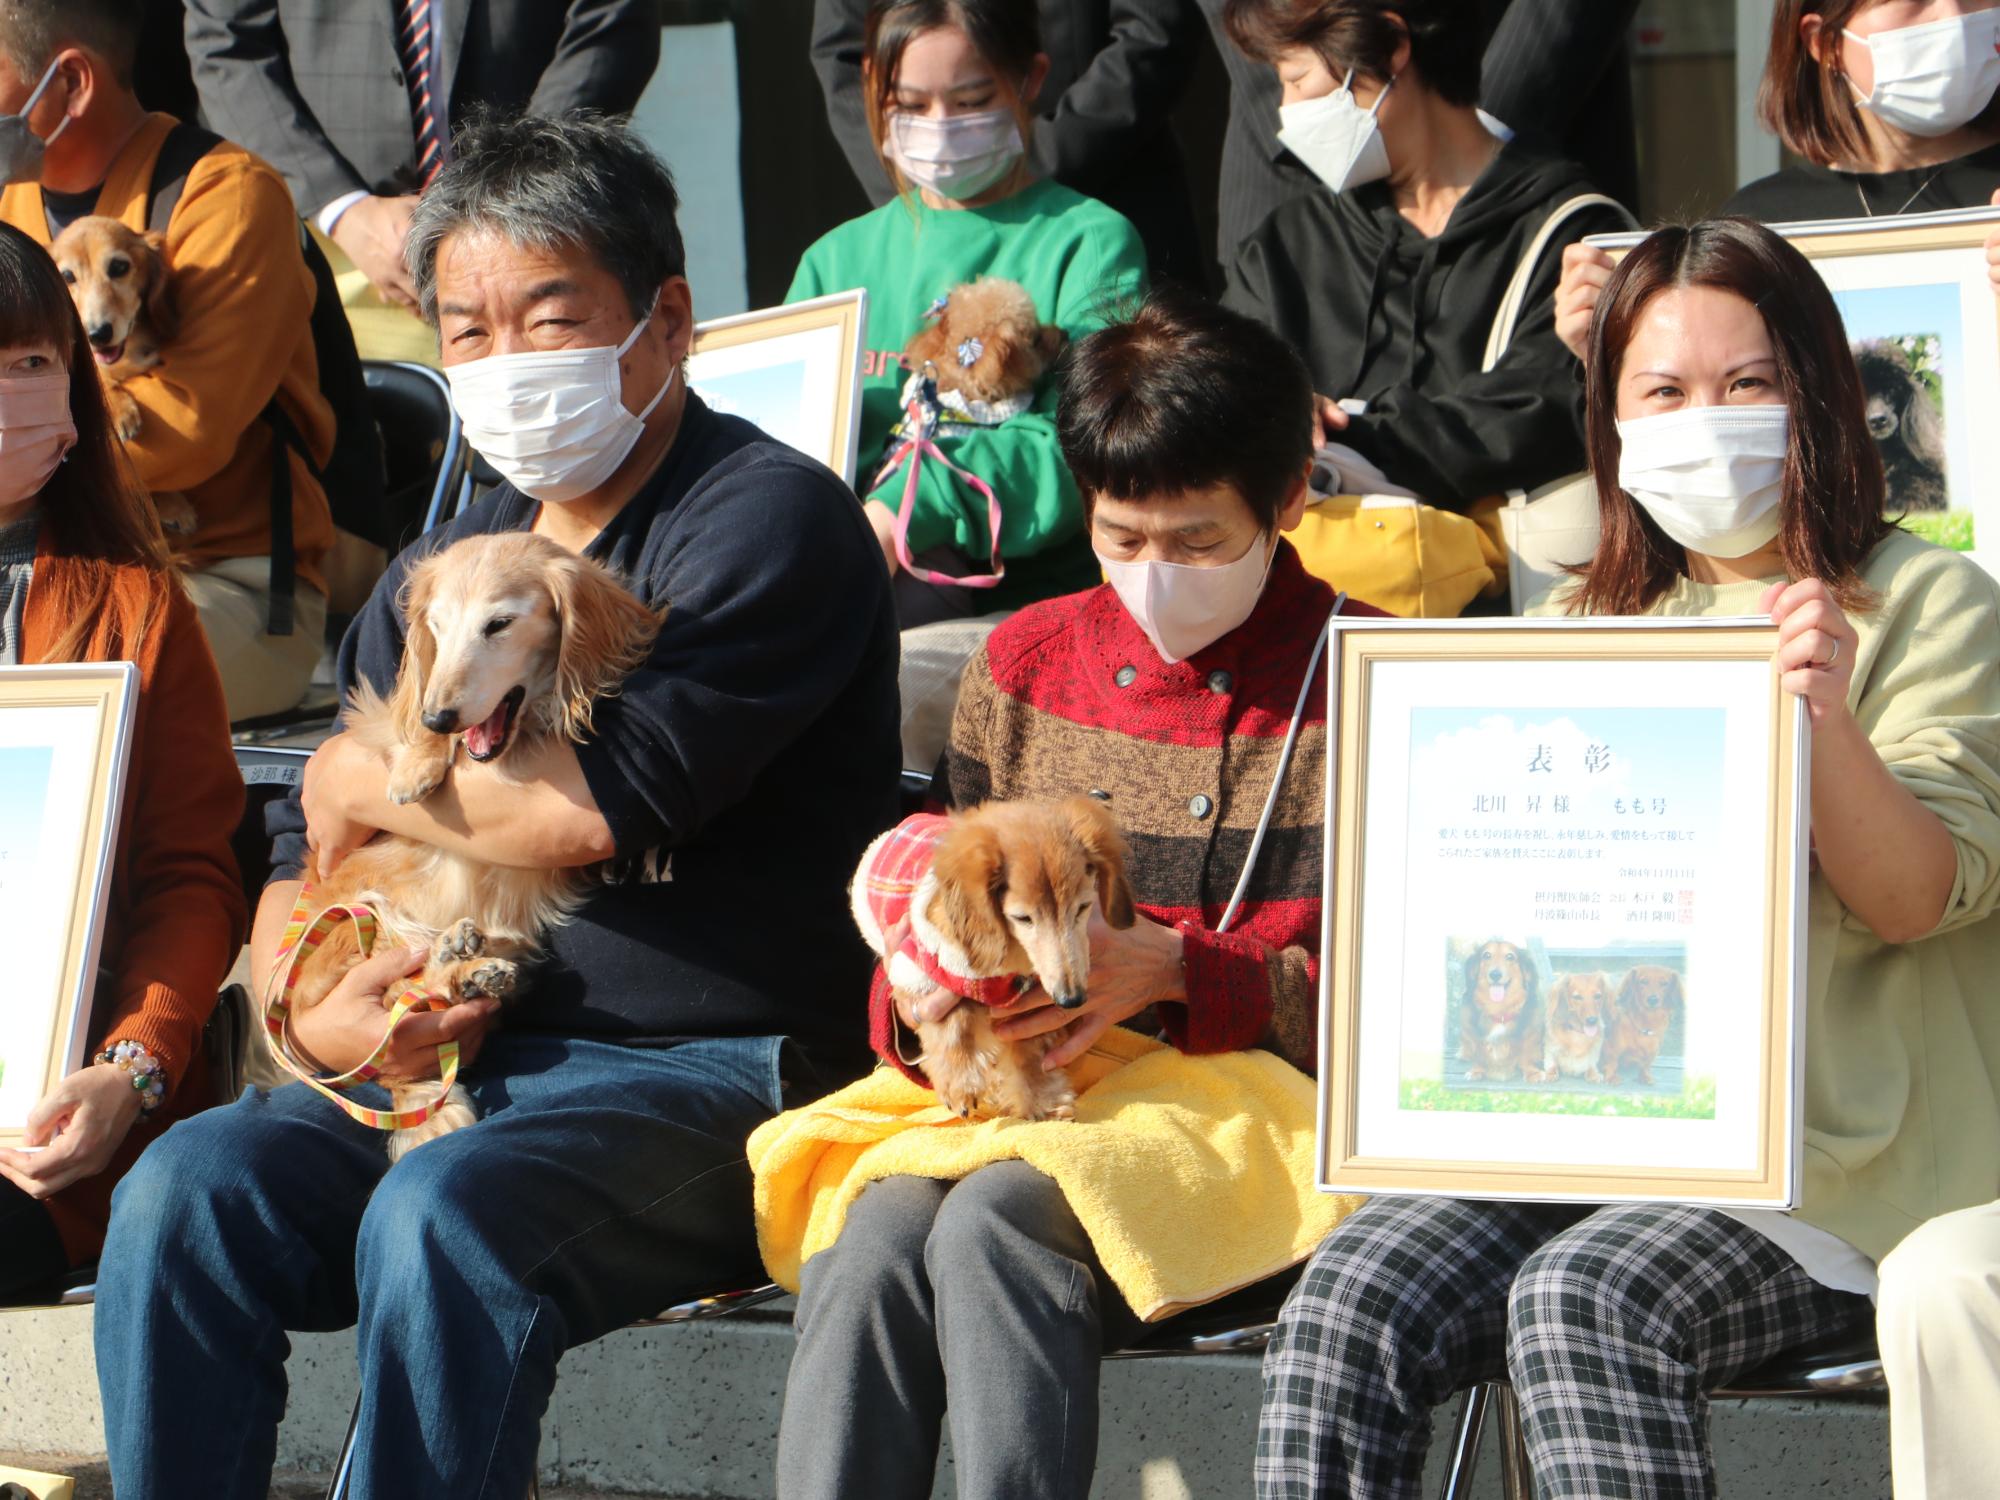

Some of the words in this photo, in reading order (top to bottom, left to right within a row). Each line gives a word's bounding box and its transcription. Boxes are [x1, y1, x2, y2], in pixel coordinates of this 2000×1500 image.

[281, 766, 298, 783] 様
[1471, 794, 1507, 814] 北川
[1553, 794, 1571, 814] 様
[1612, 797, 1668, 816] もも号
